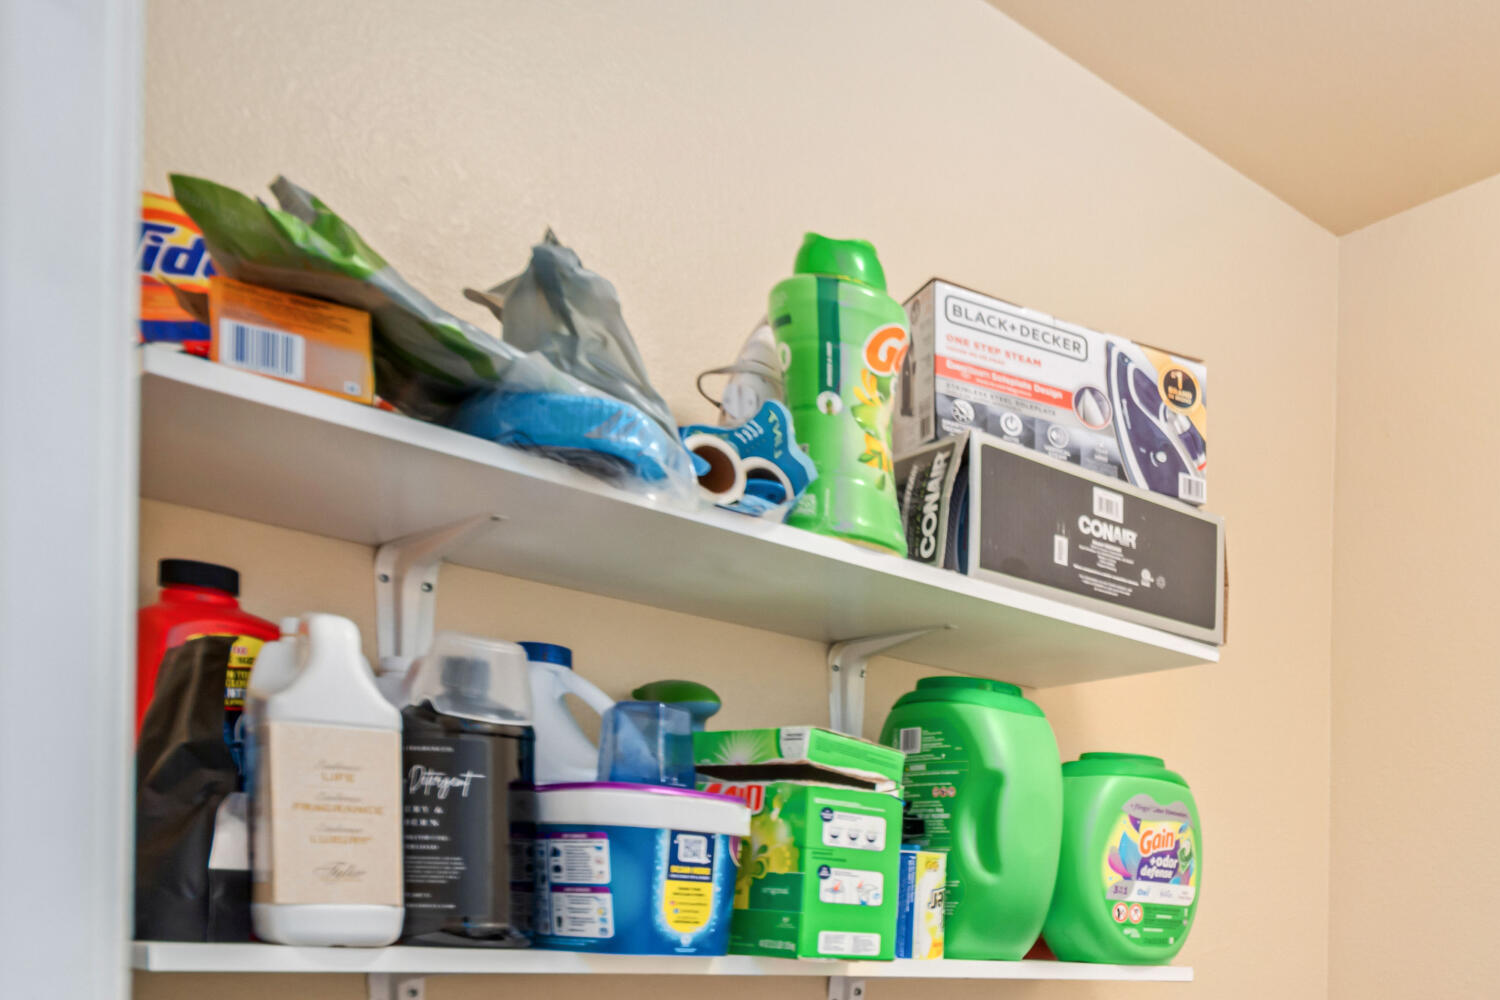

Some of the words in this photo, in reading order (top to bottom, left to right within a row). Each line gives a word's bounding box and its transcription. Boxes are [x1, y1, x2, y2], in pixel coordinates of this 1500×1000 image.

[952, 303, 1082, 354] BLACK+DECKER
[946, 334, 970, 347] ONE
[1004, 350, 1042, 367] STEAM
[920, 451, 951, 559] CONAIR
[1078, 515, 1138, 549] CONAIR
[1140, 829, 1175, 855] Gain
